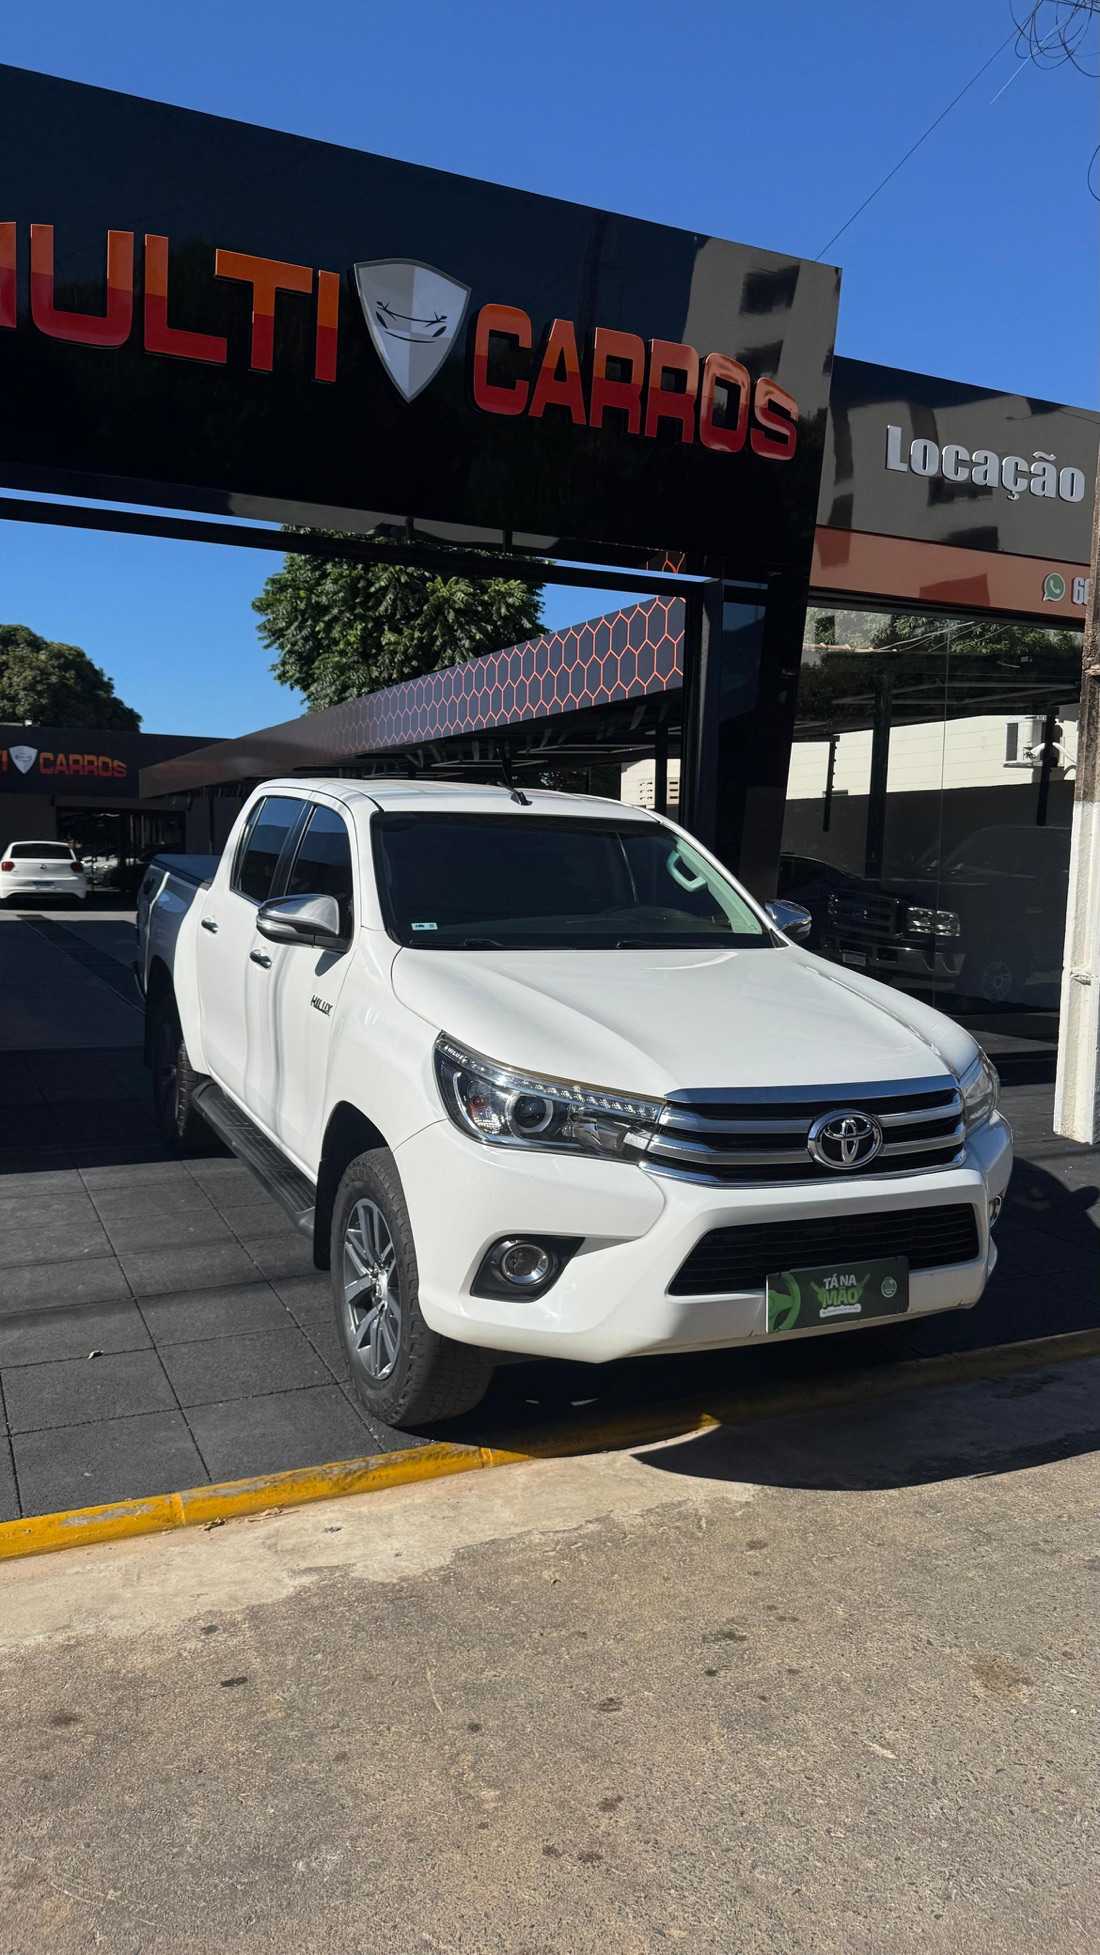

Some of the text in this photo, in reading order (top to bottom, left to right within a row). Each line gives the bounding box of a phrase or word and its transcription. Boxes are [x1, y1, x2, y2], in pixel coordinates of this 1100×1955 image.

[472, 303, 799, 461] CARROS
[886, 424, 1086, 503] Locação
[40, 752, 127, 778] CARROS
[310, 994, 333, 1016] HILUX
[823, 1273, 857, 1290] TÁ NA
[822, 1285, 858, 1308] MÃO
